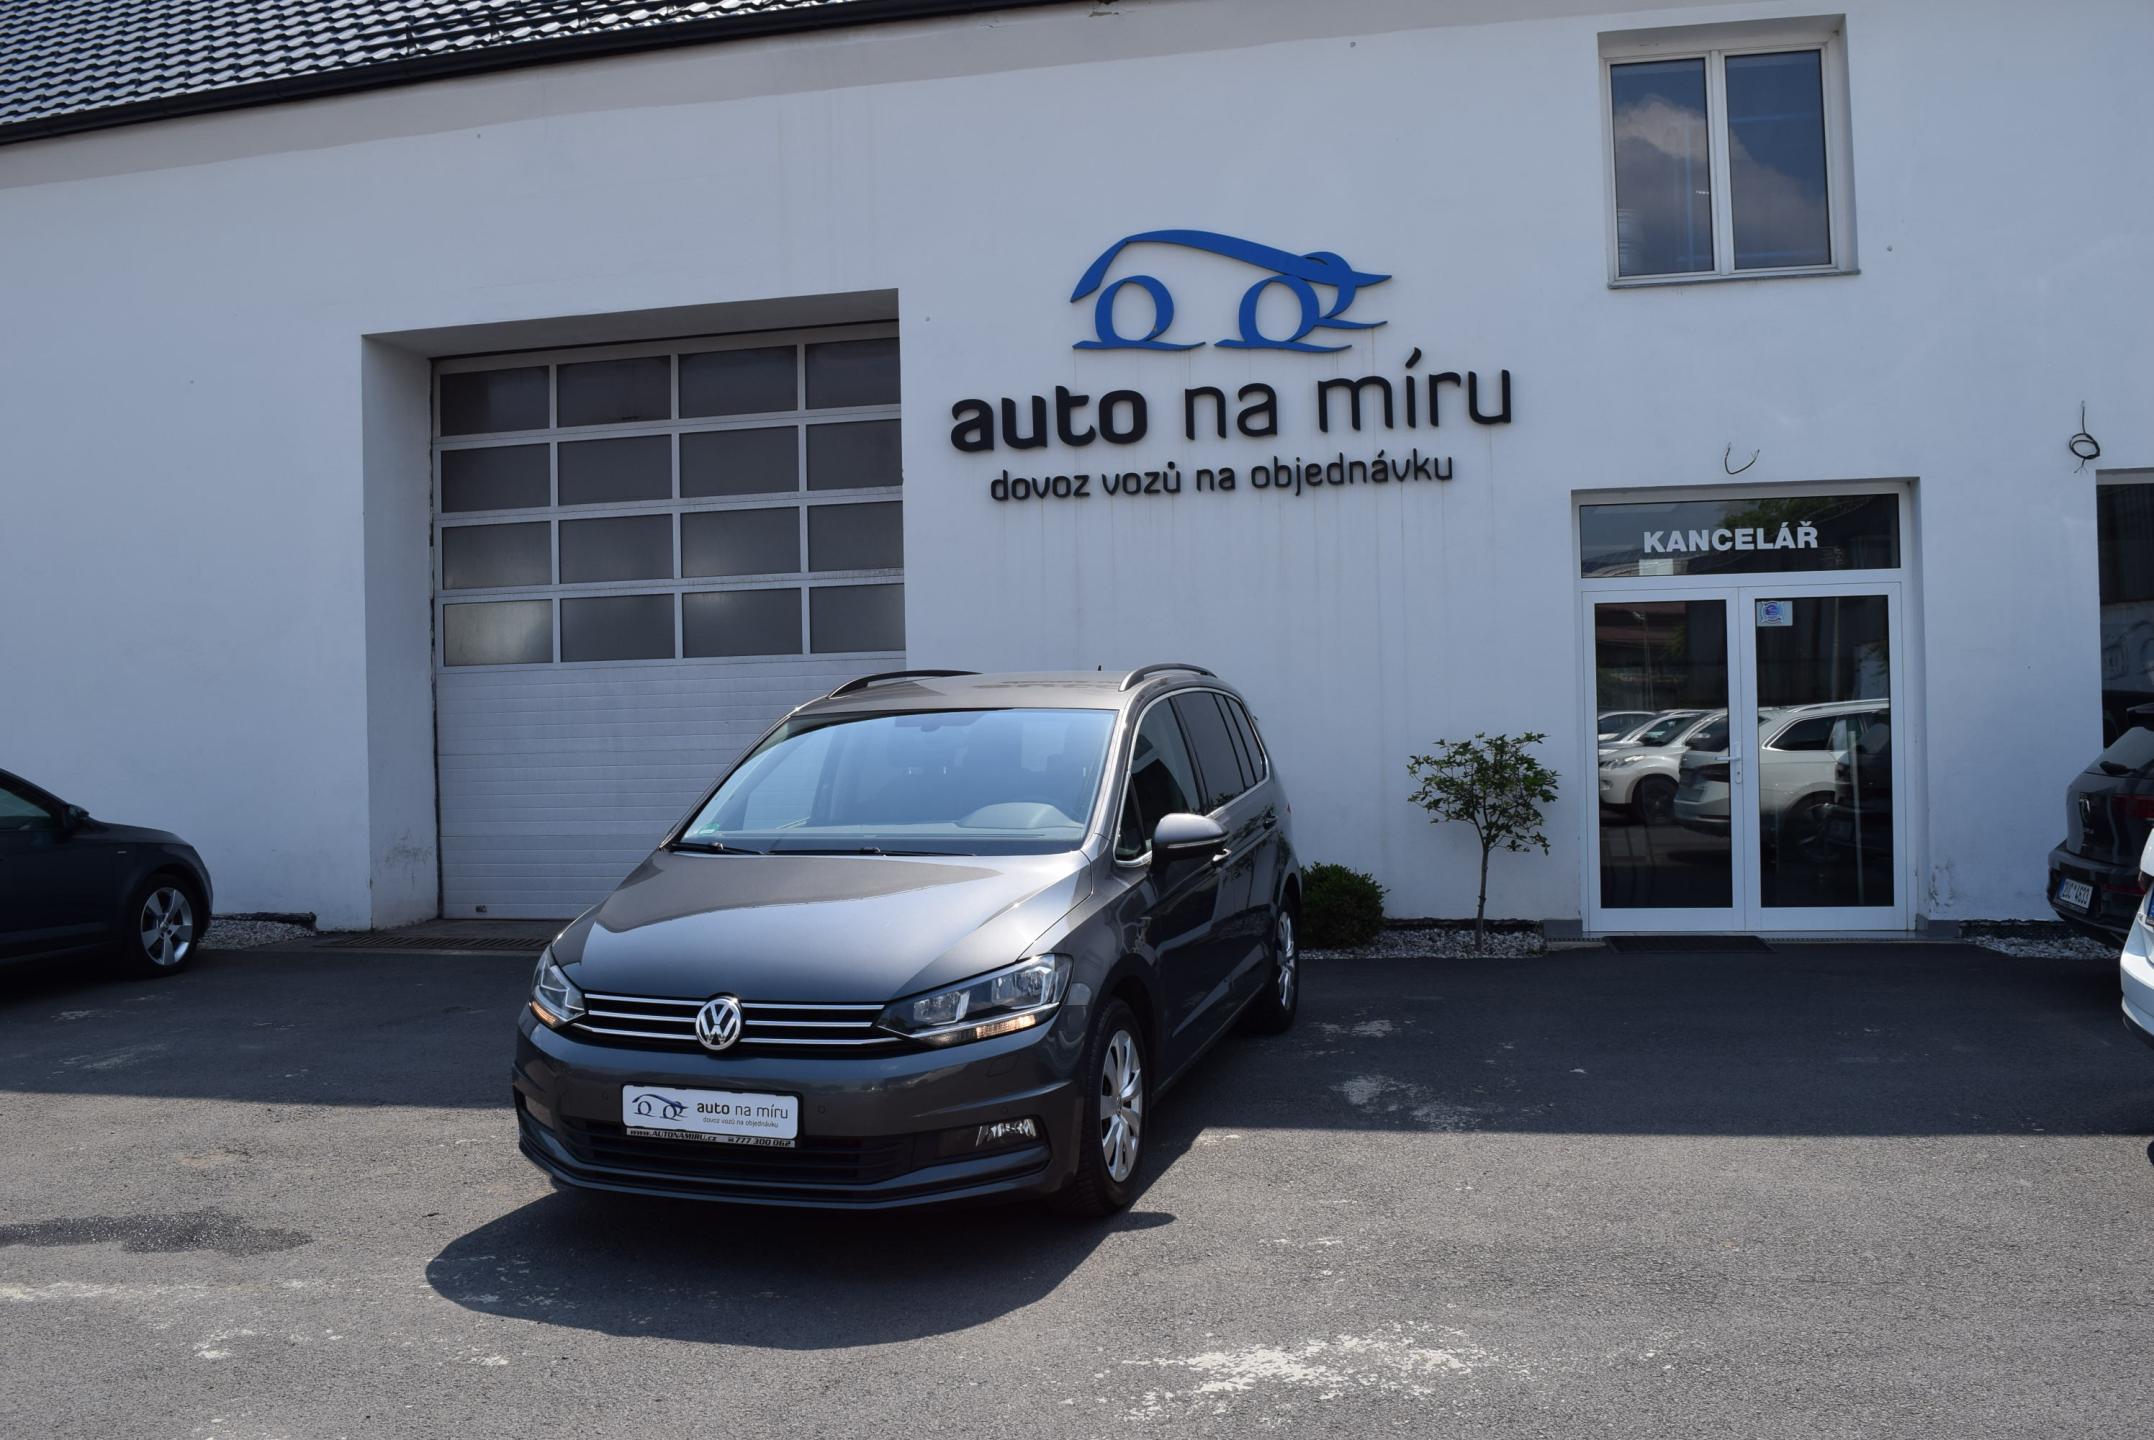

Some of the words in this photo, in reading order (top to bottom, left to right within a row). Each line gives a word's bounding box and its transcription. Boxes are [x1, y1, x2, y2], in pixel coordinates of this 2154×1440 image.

[950, 385, 1148, 453] auto
[1184, 382, 1278, 440] na
[1317, 347, 1512, 434] míru
[990, 469, 1091, 502] dovoz
[1101, 461, 1182, 497] vozů
[1196, 467, 1236, 492] na
[1250, 448, 1454, 497] objednávku
[1643, 521, 1818, 553] KANCELÁŘ
[696, 1102, 730, 1115] auto
[735, 1105, 751, 1117] na
[756, 1103, 789, 1119] míru
